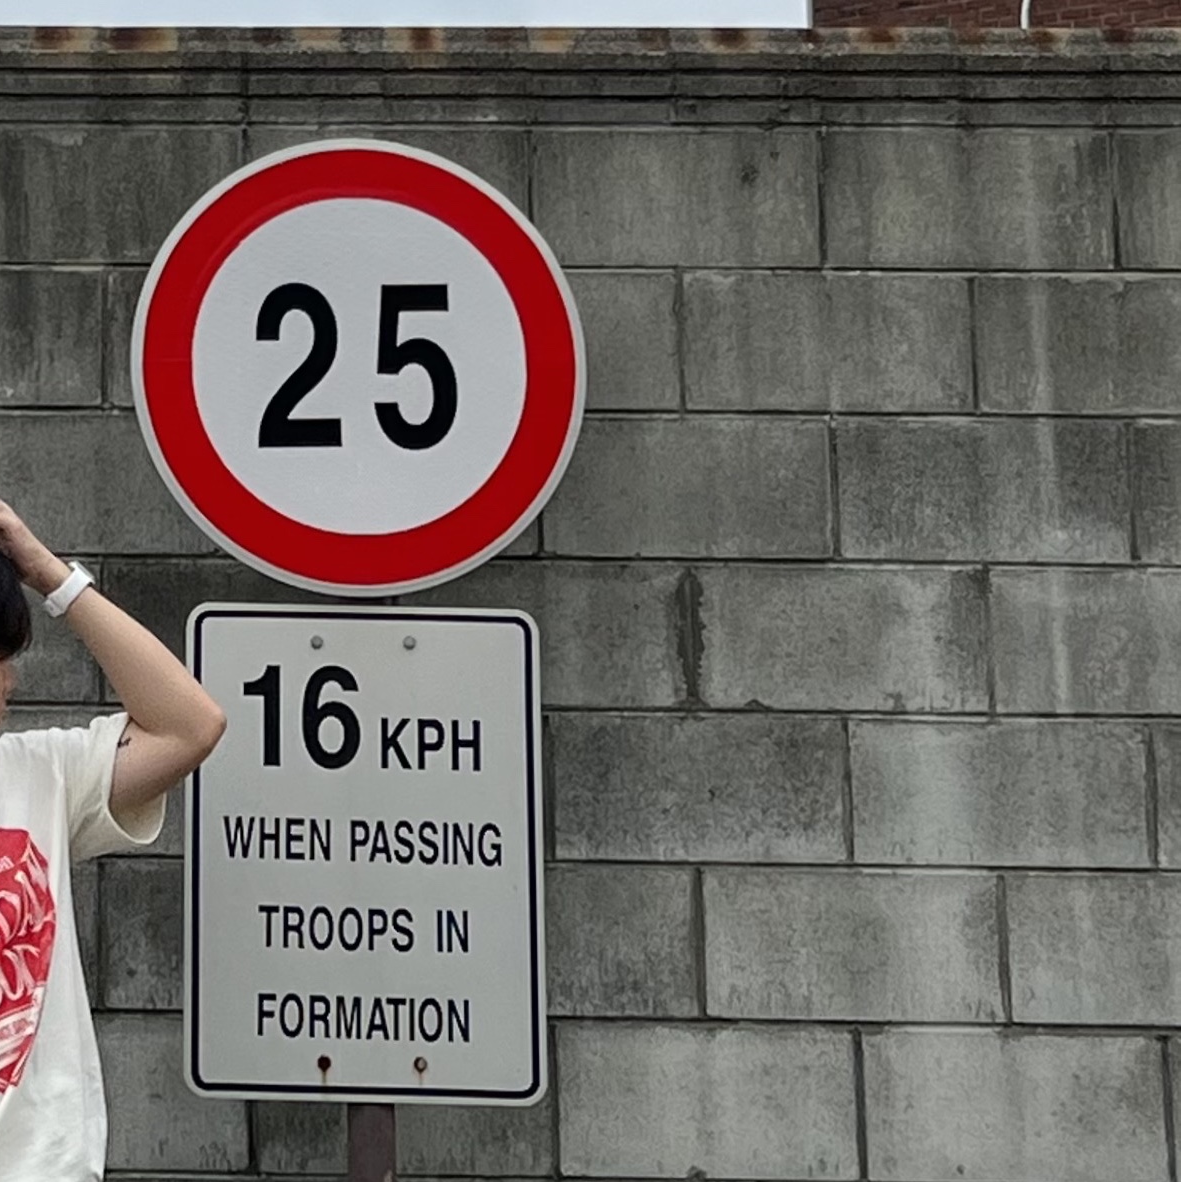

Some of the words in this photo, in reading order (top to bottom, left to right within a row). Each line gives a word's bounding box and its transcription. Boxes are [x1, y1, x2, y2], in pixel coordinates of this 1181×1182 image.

[255, 282, 458, 451] 25
[243, 664, 361, 770] 16
[380, 716, 482, 772] KPH
[222, 815, 331, 862] WHEN
[349, 819, 502, 867] PASSING
[257, 904, 415, 953] TROOPS
[436, 909, 469, 954] IN
[257, 992, 470, 1043] FORMATION
